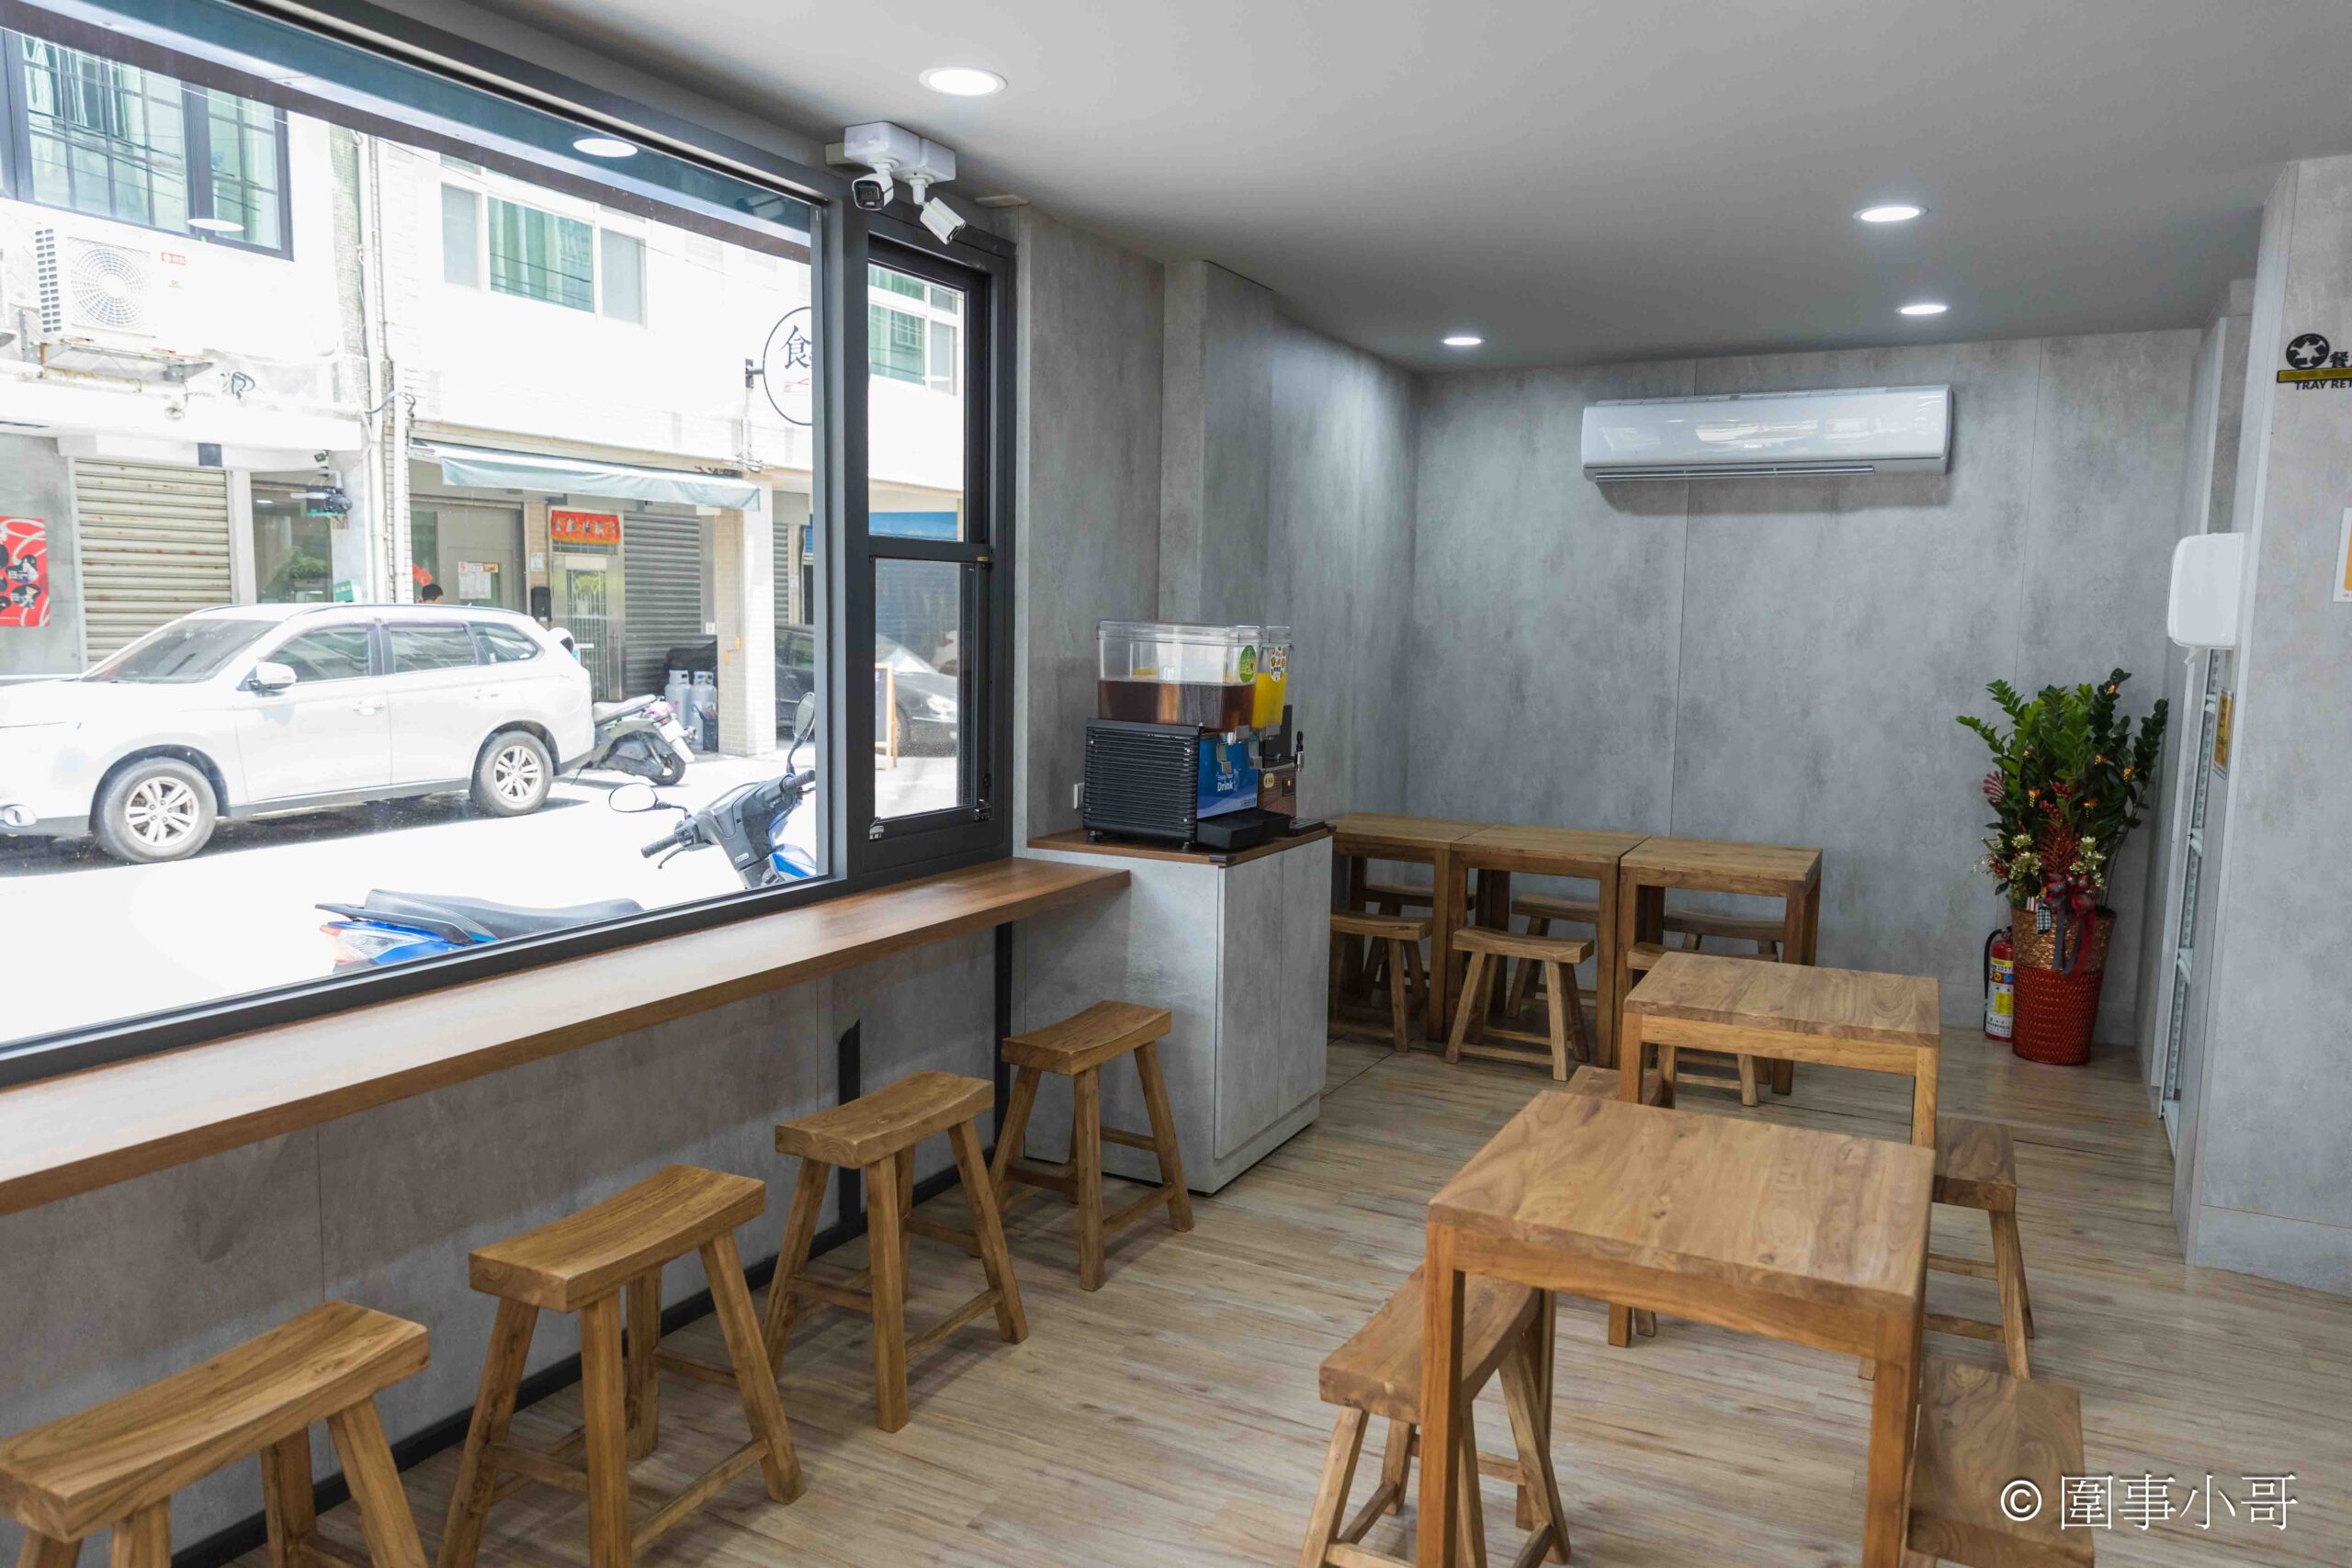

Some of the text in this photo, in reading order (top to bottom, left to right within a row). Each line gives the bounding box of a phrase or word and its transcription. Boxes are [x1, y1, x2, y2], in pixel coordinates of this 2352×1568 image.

[2329, 351, 2352, 368] 餐
[2294, 378, 2328, 390] TRAY
[1216, 780, 1234, 792] Drink
